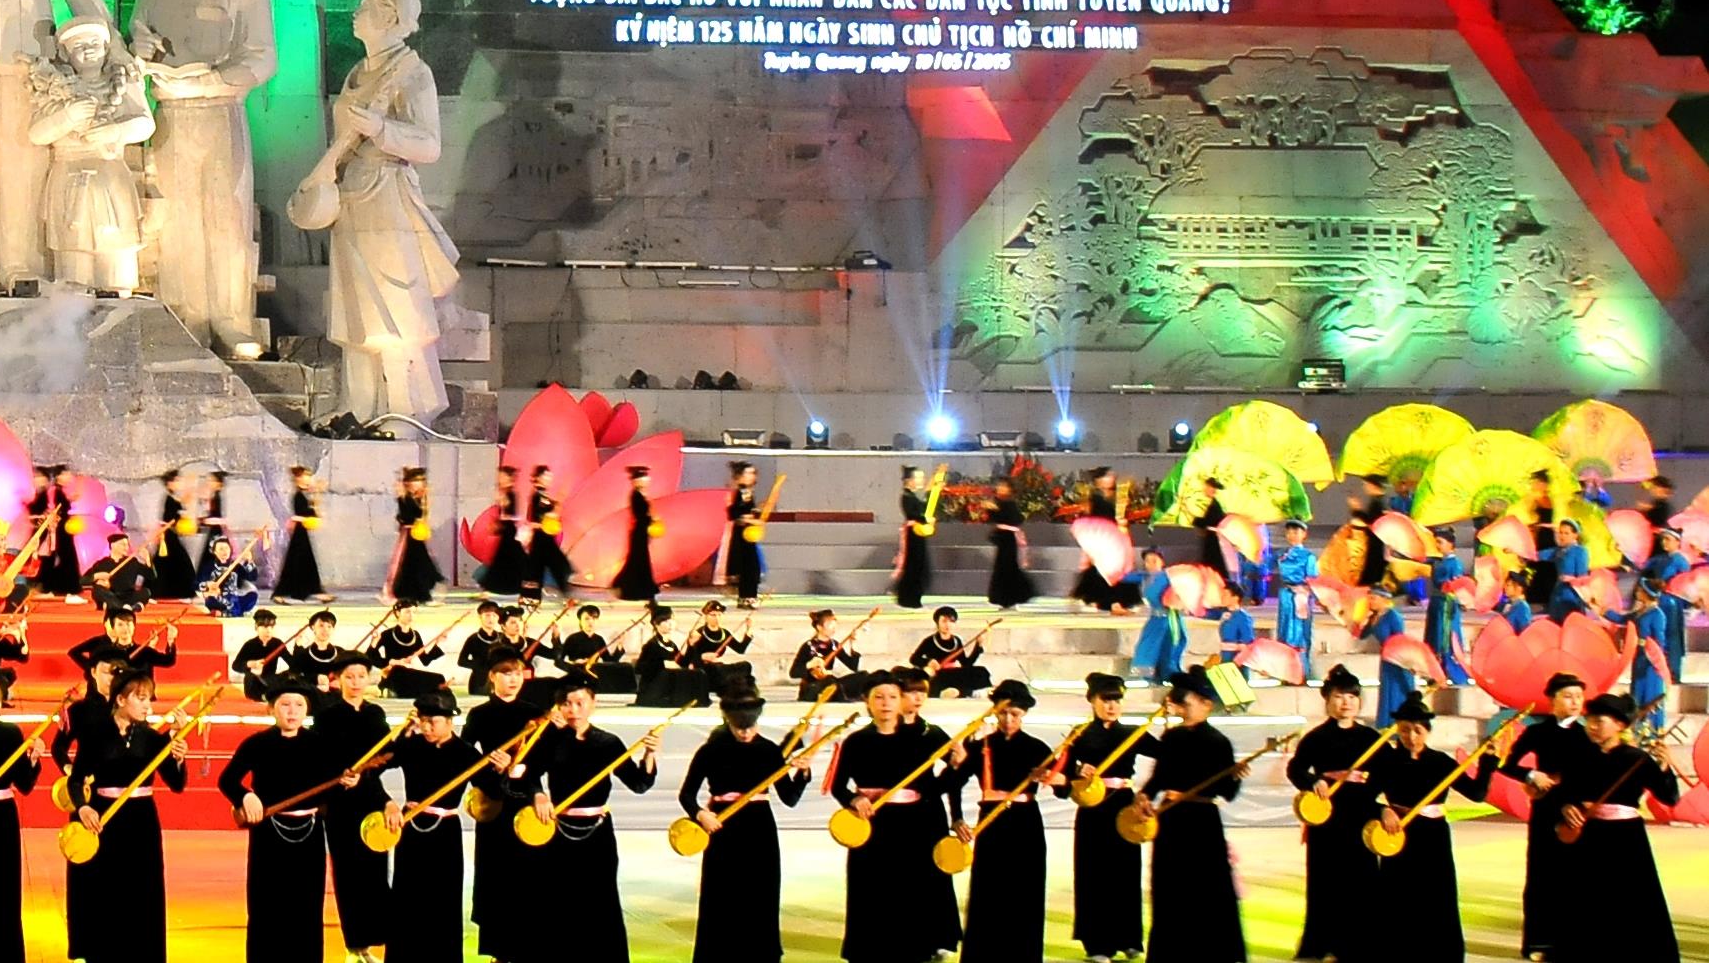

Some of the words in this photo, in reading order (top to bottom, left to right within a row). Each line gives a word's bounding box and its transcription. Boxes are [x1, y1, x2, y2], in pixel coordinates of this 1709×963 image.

[698, 20, 734, 44] 125
[738, 15, 784, 44] NĂM
[789, 16, 842, 45] NGÀY
[847, 21, 895, 46] SINH
[901, 16, 942, 47] CHỦ
[947, 23, 995, 51] TỊCH
[1040, 19, 1078, 49] CHÍ
[1084, 26, 1138, 50] MINH
[815, 52, 867, 74] Quang
[870, 51, 912, 74] ngày
